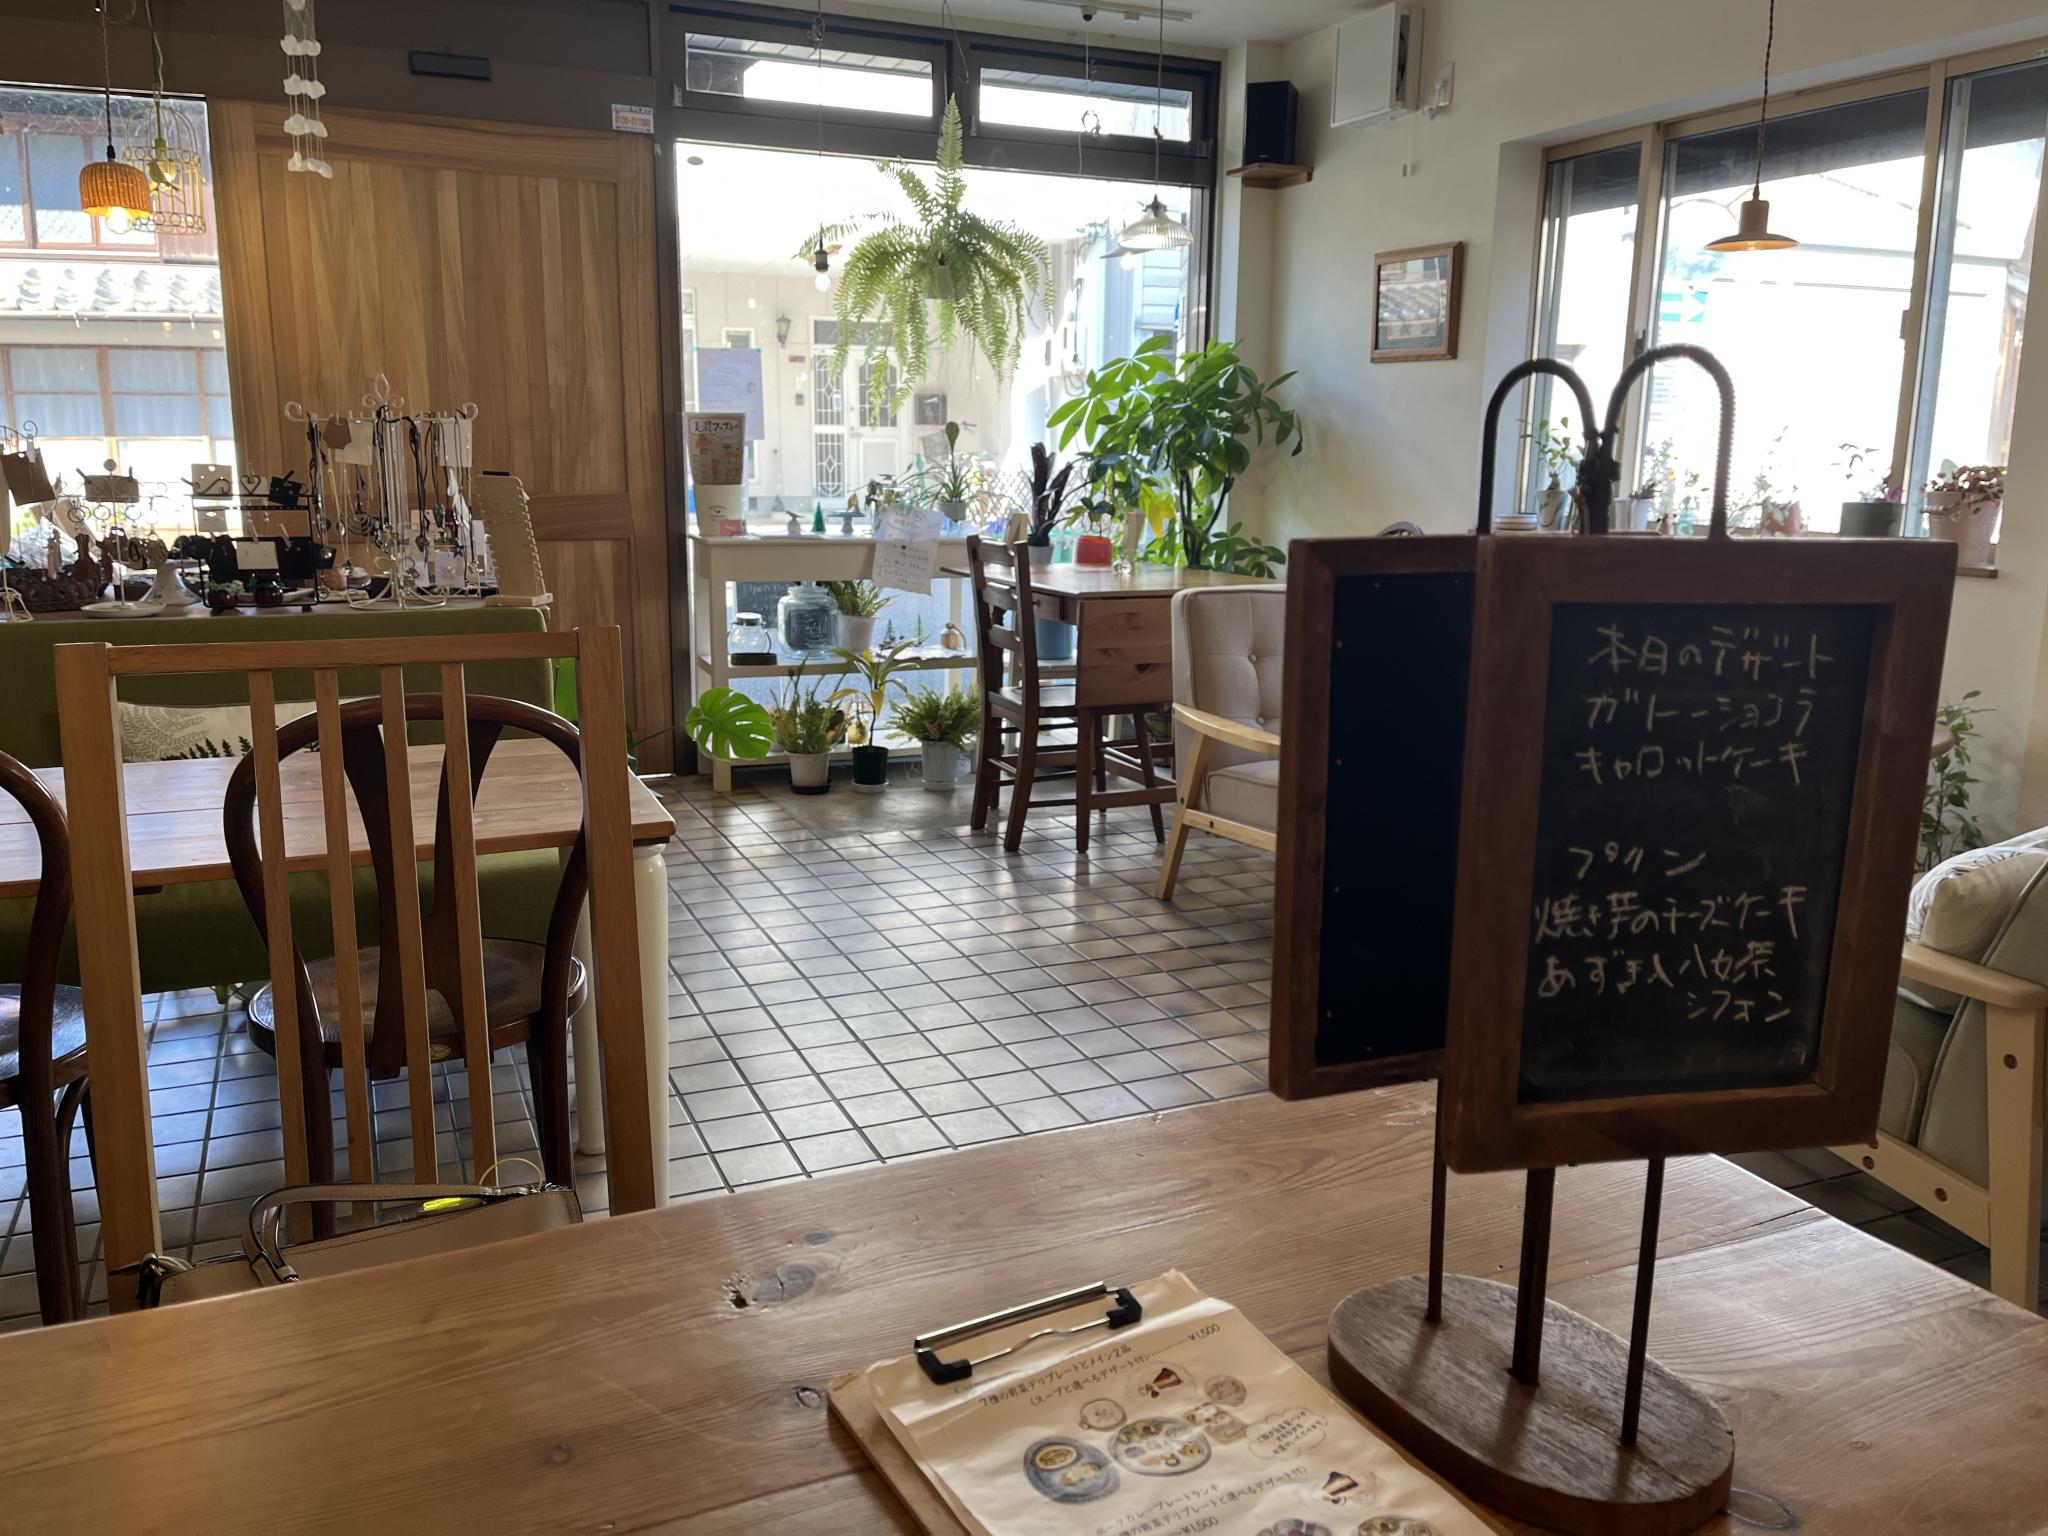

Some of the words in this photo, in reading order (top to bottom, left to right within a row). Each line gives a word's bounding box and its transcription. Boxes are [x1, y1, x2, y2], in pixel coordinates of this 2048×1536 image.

[1588, 623, 1834, 681] 本日のデザート
[1586, 687, 1815, 737] ガトーショコラ
[1574, 741, 1810, 786] キャロットケーキ
[1569, 842, 1706, 880] プリン
[1687, 990, 1792, 1023] シフォン
